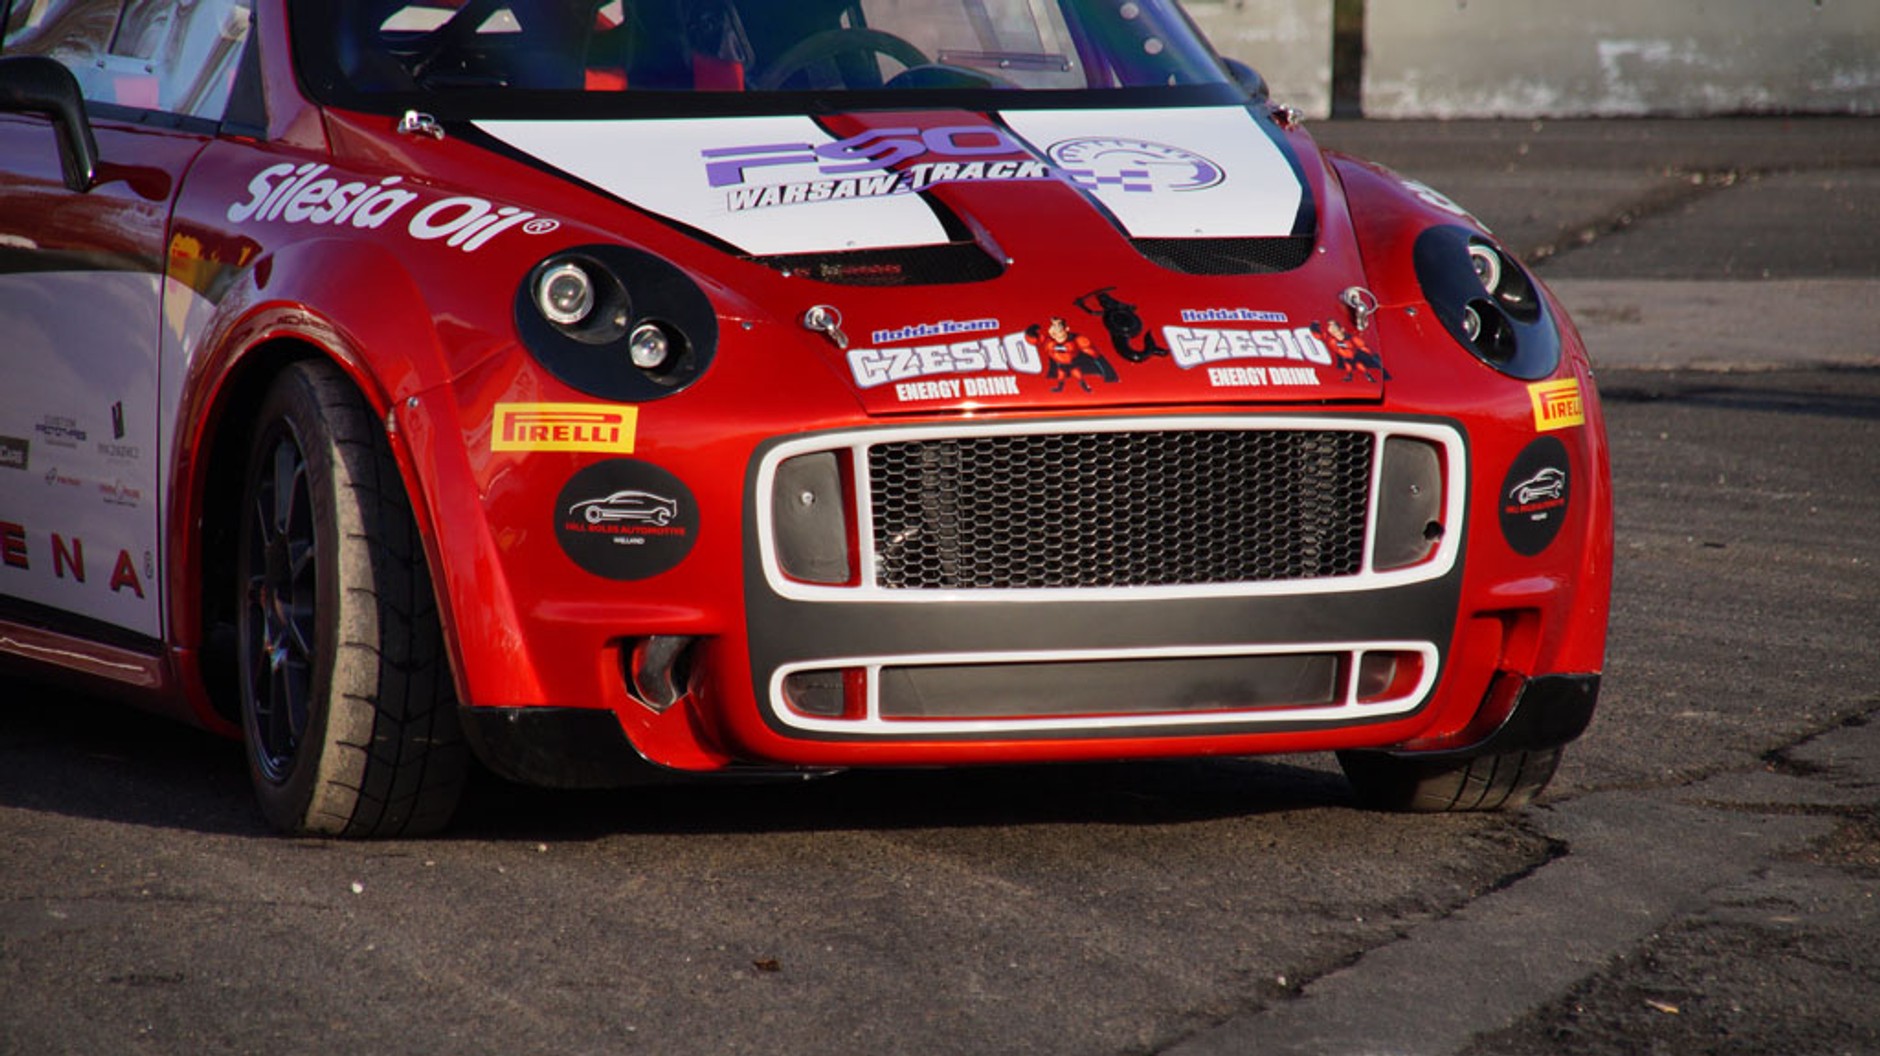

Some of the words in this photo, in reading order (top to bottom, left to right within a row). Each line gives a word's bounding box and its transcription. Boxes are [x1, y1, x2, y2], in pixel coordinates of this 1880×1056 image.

[227, 162, 418, 229] Silesia
[727, 172, 901, 213] WARSAW
[909, 160, 1052, 192] TRACK
[847, 330, 1043, 390] CZESIO
[1162, 325, 1332, 371] CZESIO
[895, 378, 961, 402] ENERGY
[962, 375, 1020, 398] DRINK
[1207, 367, 1268, 387] ENERGY
[1267, 367, 1321, 386] DRINK
[502, 411, 623, 442] PIRELLI
